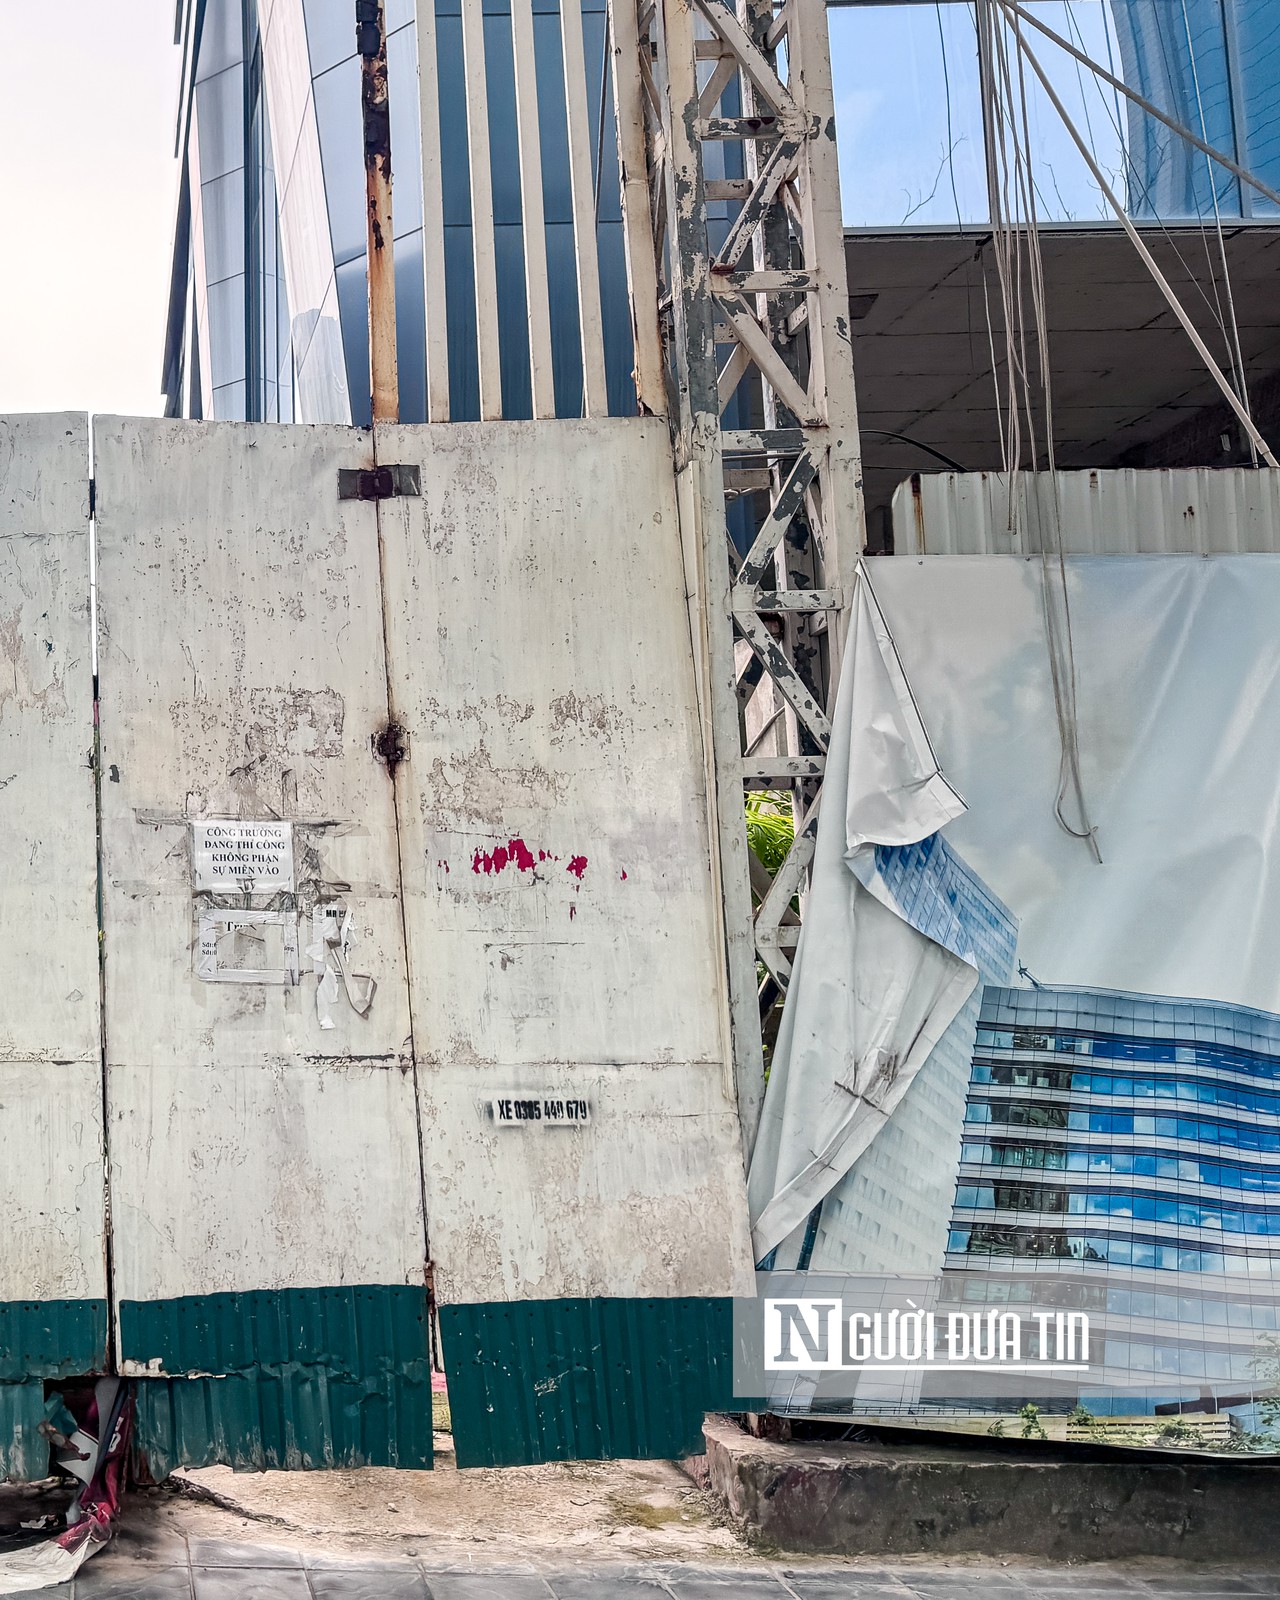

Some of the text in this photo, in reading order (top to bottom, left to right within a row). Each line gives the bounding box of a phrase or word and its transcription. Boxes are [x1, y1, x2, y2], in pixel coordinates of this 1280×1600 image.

[206, 826, 282, 837] CÔNG TRƯỜNG
[256, 839, 285, 849] CÔNG
[212, 852, 249, 862] KHÔNG
[212, 865, 226, 876] SỰ
[257, 865, 279, 875] VÀO
[497, 1100, 513, 1119] XE
[566, 1100, 588, 1119] 679
